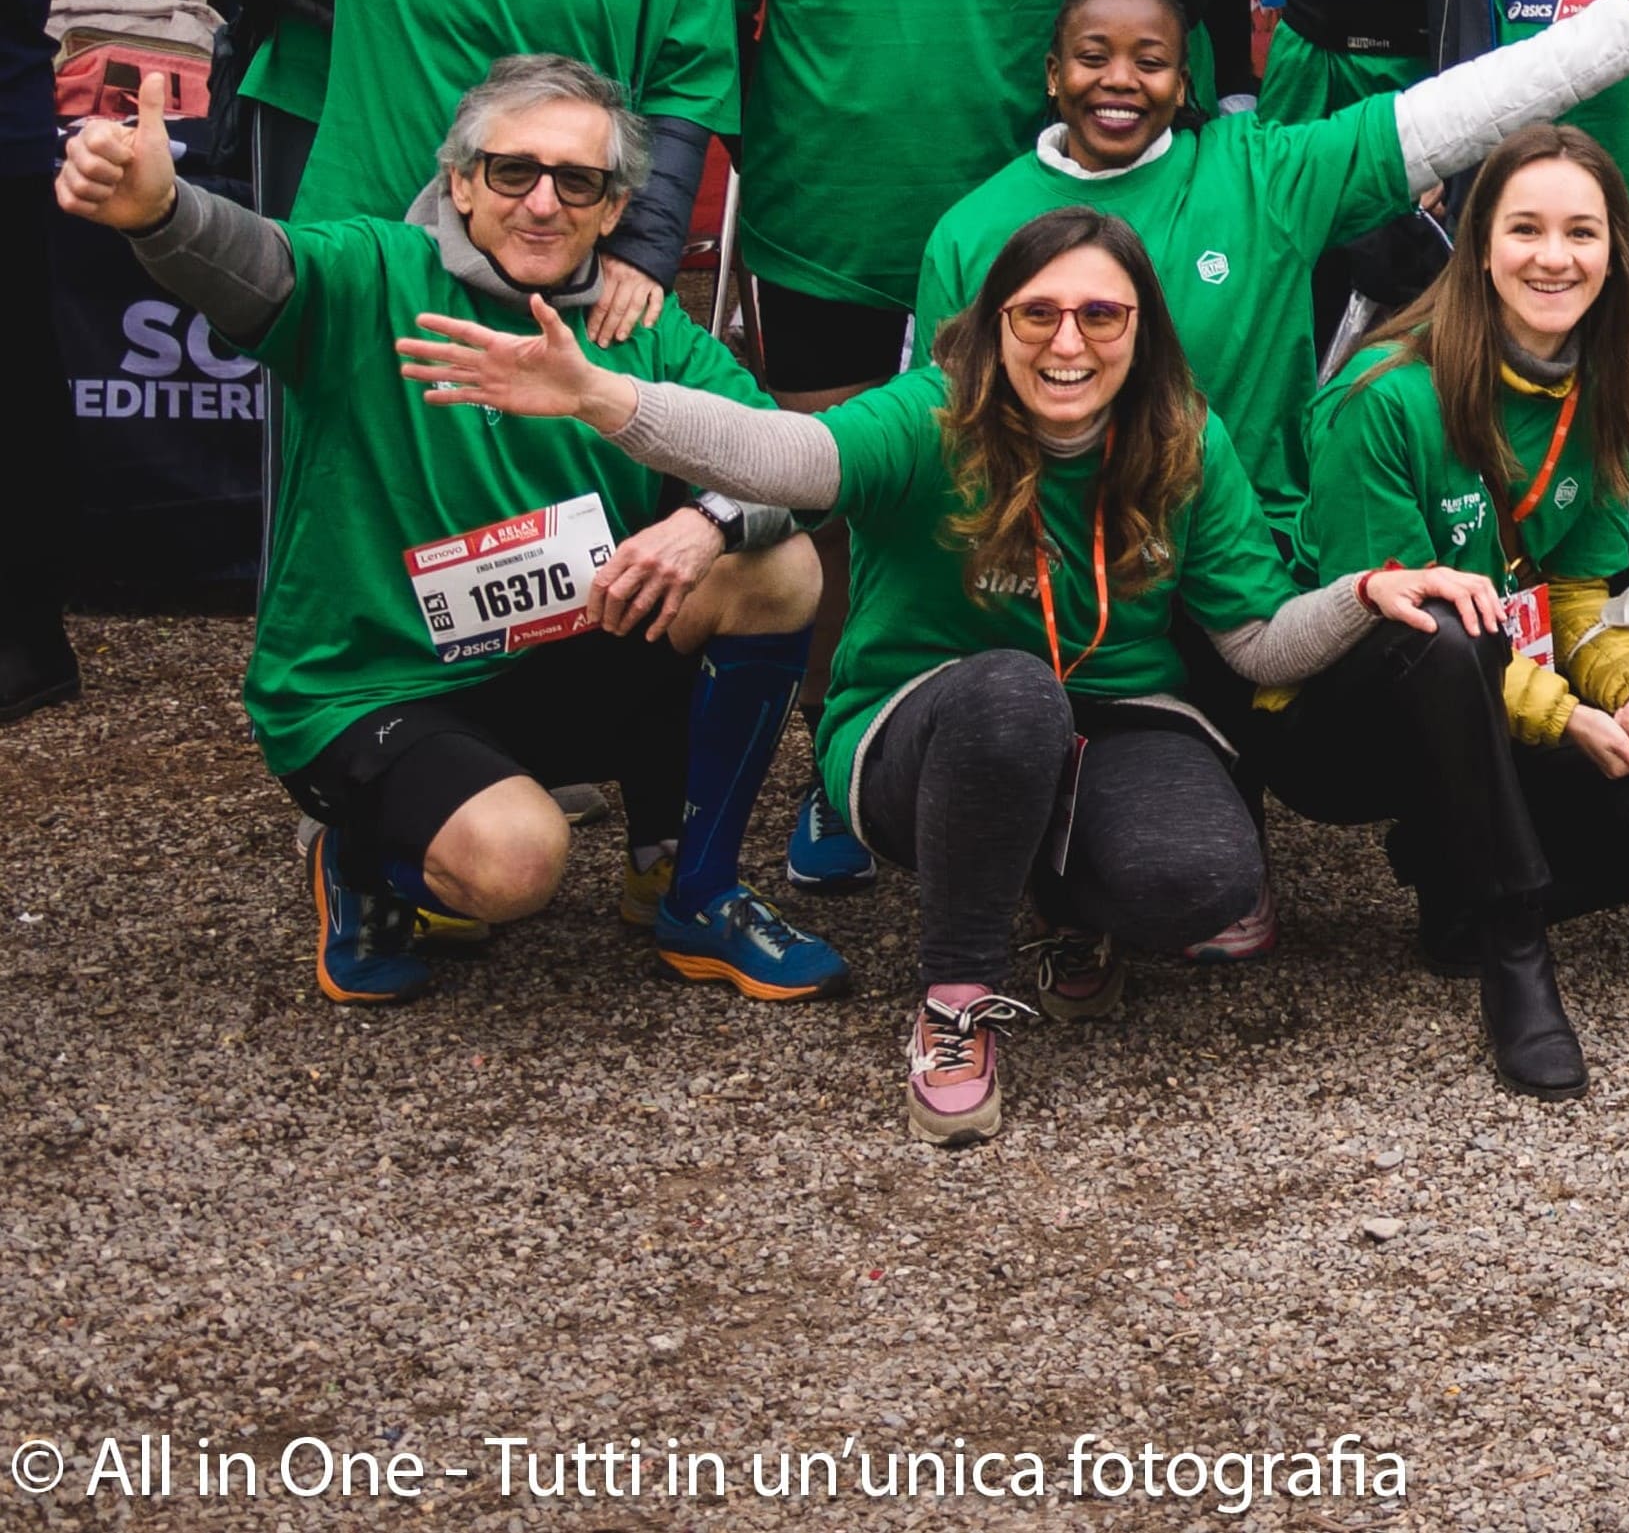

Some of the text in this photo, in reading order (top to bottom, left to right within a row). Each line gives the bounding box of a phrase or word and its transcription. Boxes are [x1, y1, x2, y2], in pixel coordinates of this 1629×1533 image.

[1520, 3, 1554, 18] asics
[119, 299, 261, 379] SO
[498, 519, 536, 538] RELAY
[419, 545, 463, 565] Lenovo
[494, 552, 524, 569] RUNNING
[468, 561, 576, 622] 1637C
[462, 624, 563, 657] asics Telepass
